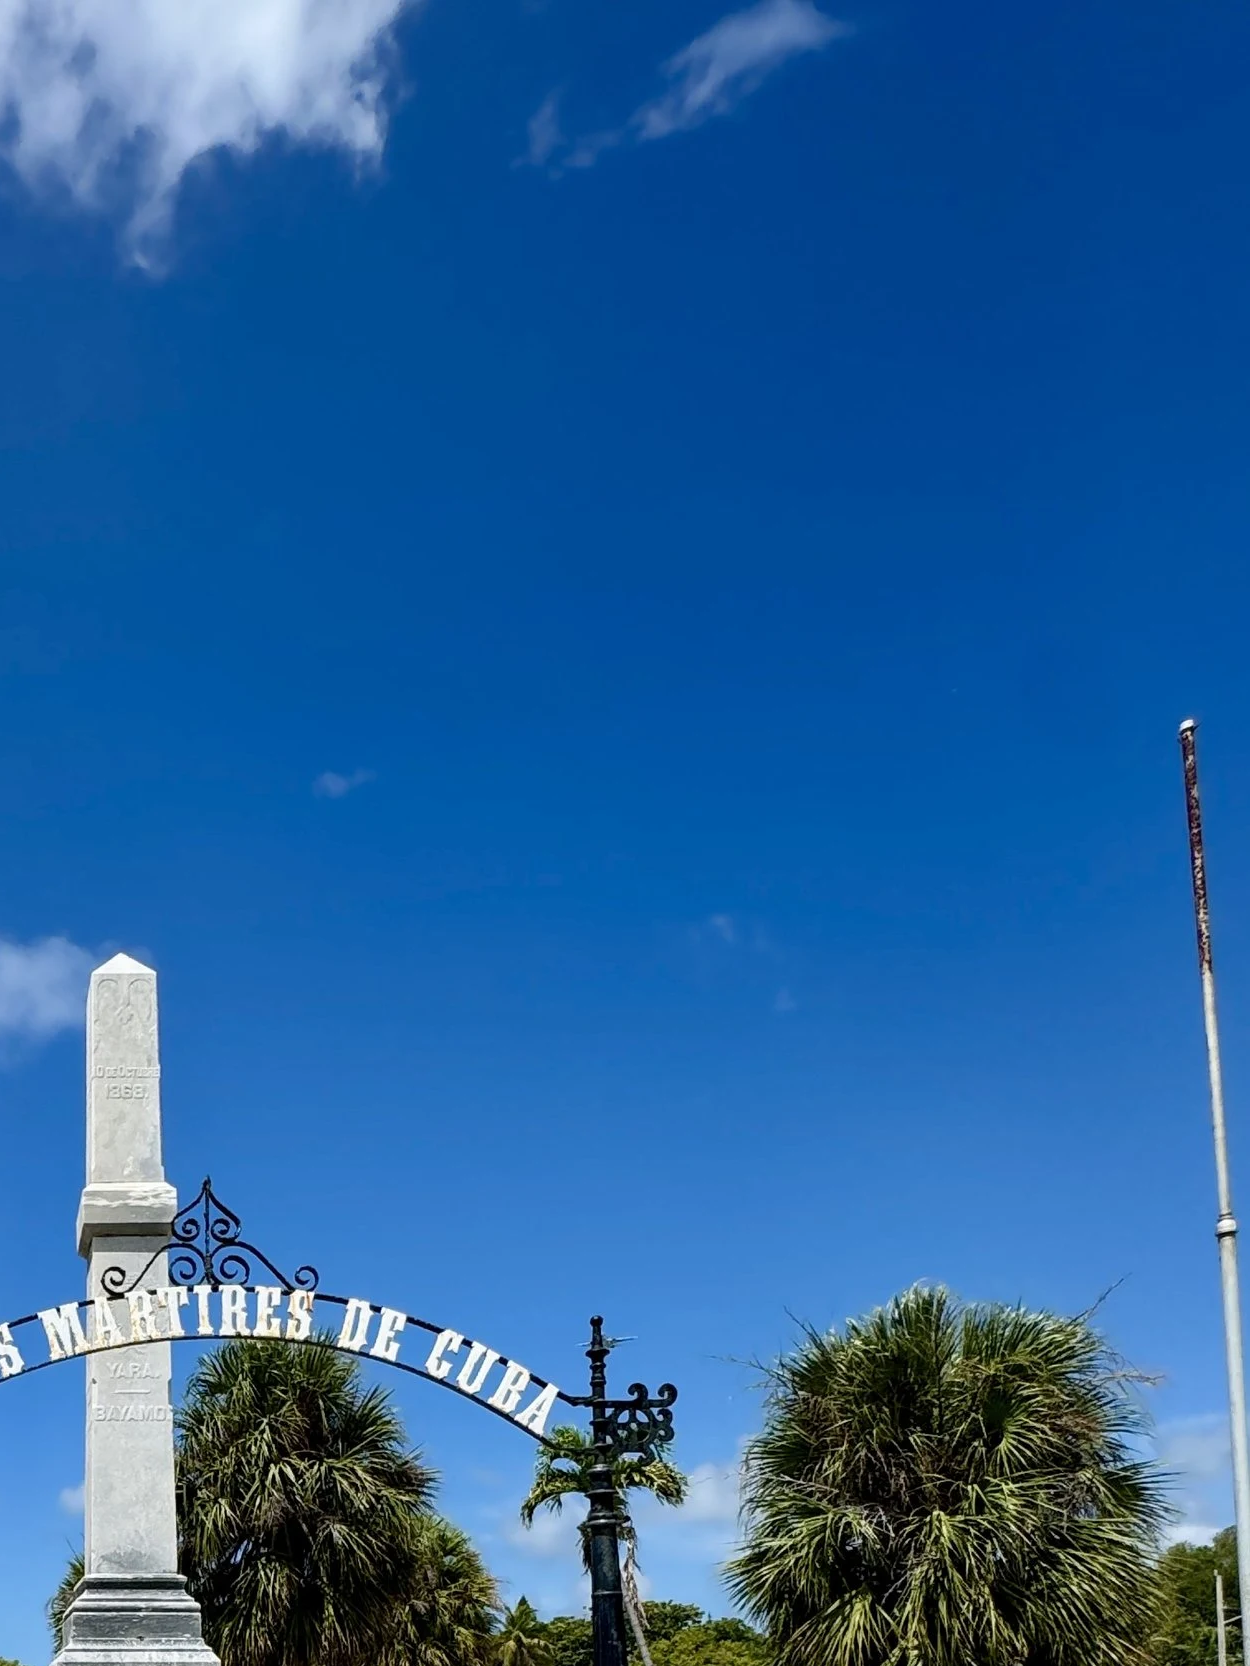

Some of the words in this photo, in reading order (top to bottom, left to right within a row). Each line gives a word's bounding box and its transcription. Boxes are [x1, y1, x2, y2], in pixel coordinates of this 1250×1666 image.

[38, 1284, 315, 1361] MARTIRES
[338, 1298, 407, 1363] DE
[425, 1329, 559, 1437] CUBA
